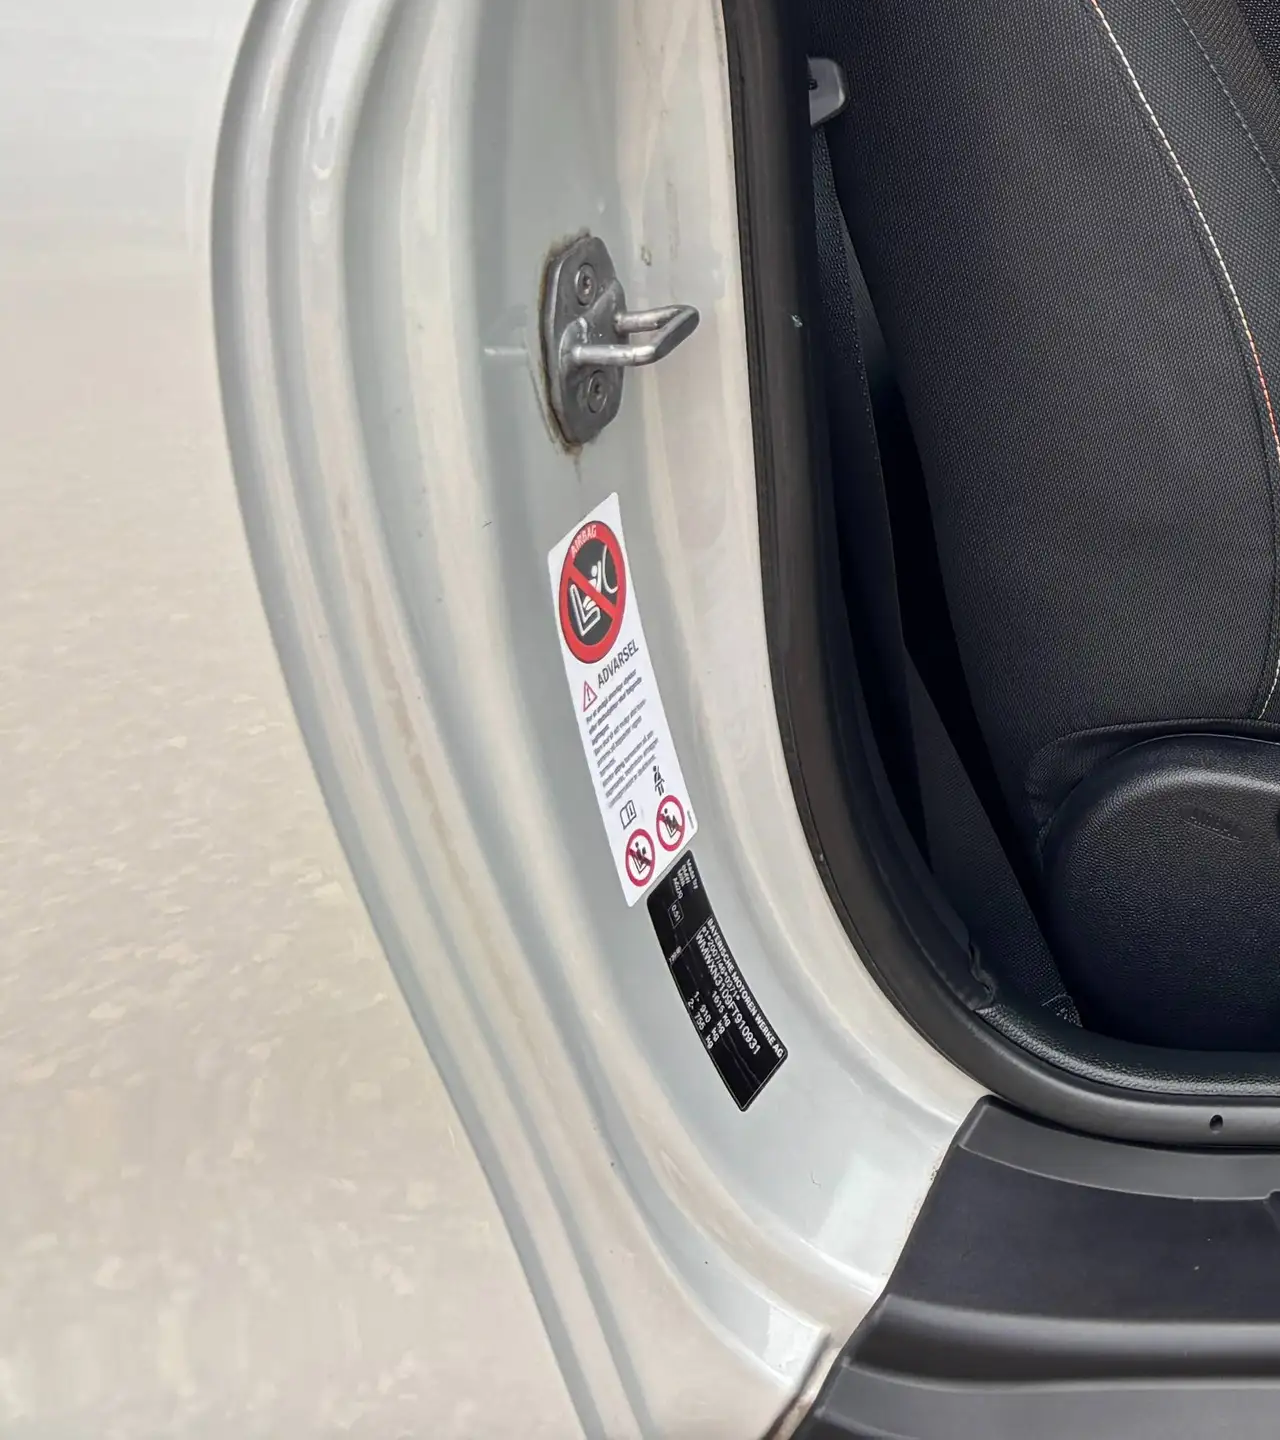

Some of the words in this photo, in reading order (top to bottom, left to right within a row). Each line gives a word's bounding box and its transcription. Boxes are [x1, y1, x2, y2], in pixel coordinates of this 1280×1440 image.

[598, 639, 639, 688] ADVARSEL
[707, 917, 735, 974] BAYERISCHE
[731, 971, 757, 1016] MOTOREN
[754, 1013, 777, 1046] WERKE
[772, 1043, 784, 1058] AG
